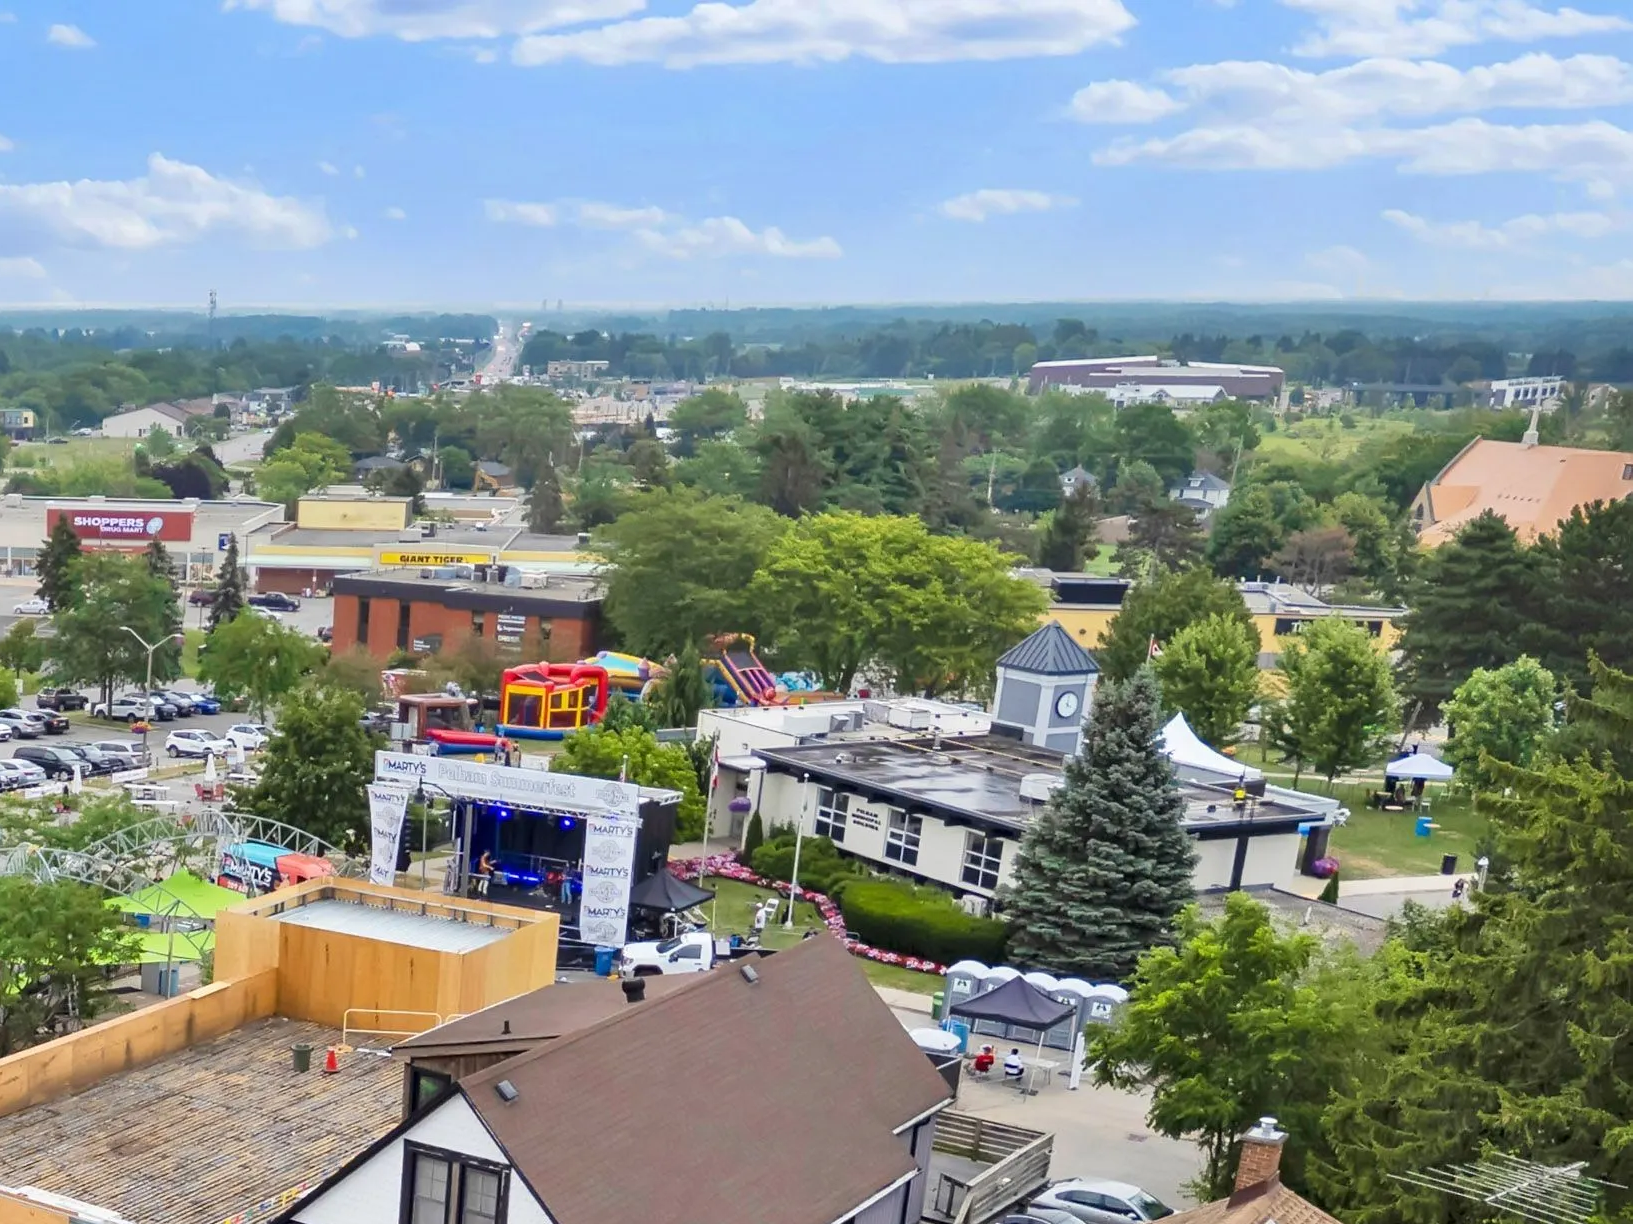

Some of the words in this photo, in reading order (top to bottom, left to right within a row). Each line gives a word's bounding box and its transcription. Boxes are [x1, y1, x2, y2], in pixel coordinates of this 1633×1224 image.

[74, 516, 144, 527] SHOPPERS
[400, 555, 431, 563] GIANT
[434, 555, 464, 564] TIGER
[387, 760, 427, 774] MARTY'S
[437, 763, 487, 785] Pelham
[490, 771, 576, 798] Summerfest
[593, 825, 633, 836] MARTY'S
[590, 866, 628, 877] MARTY'S
